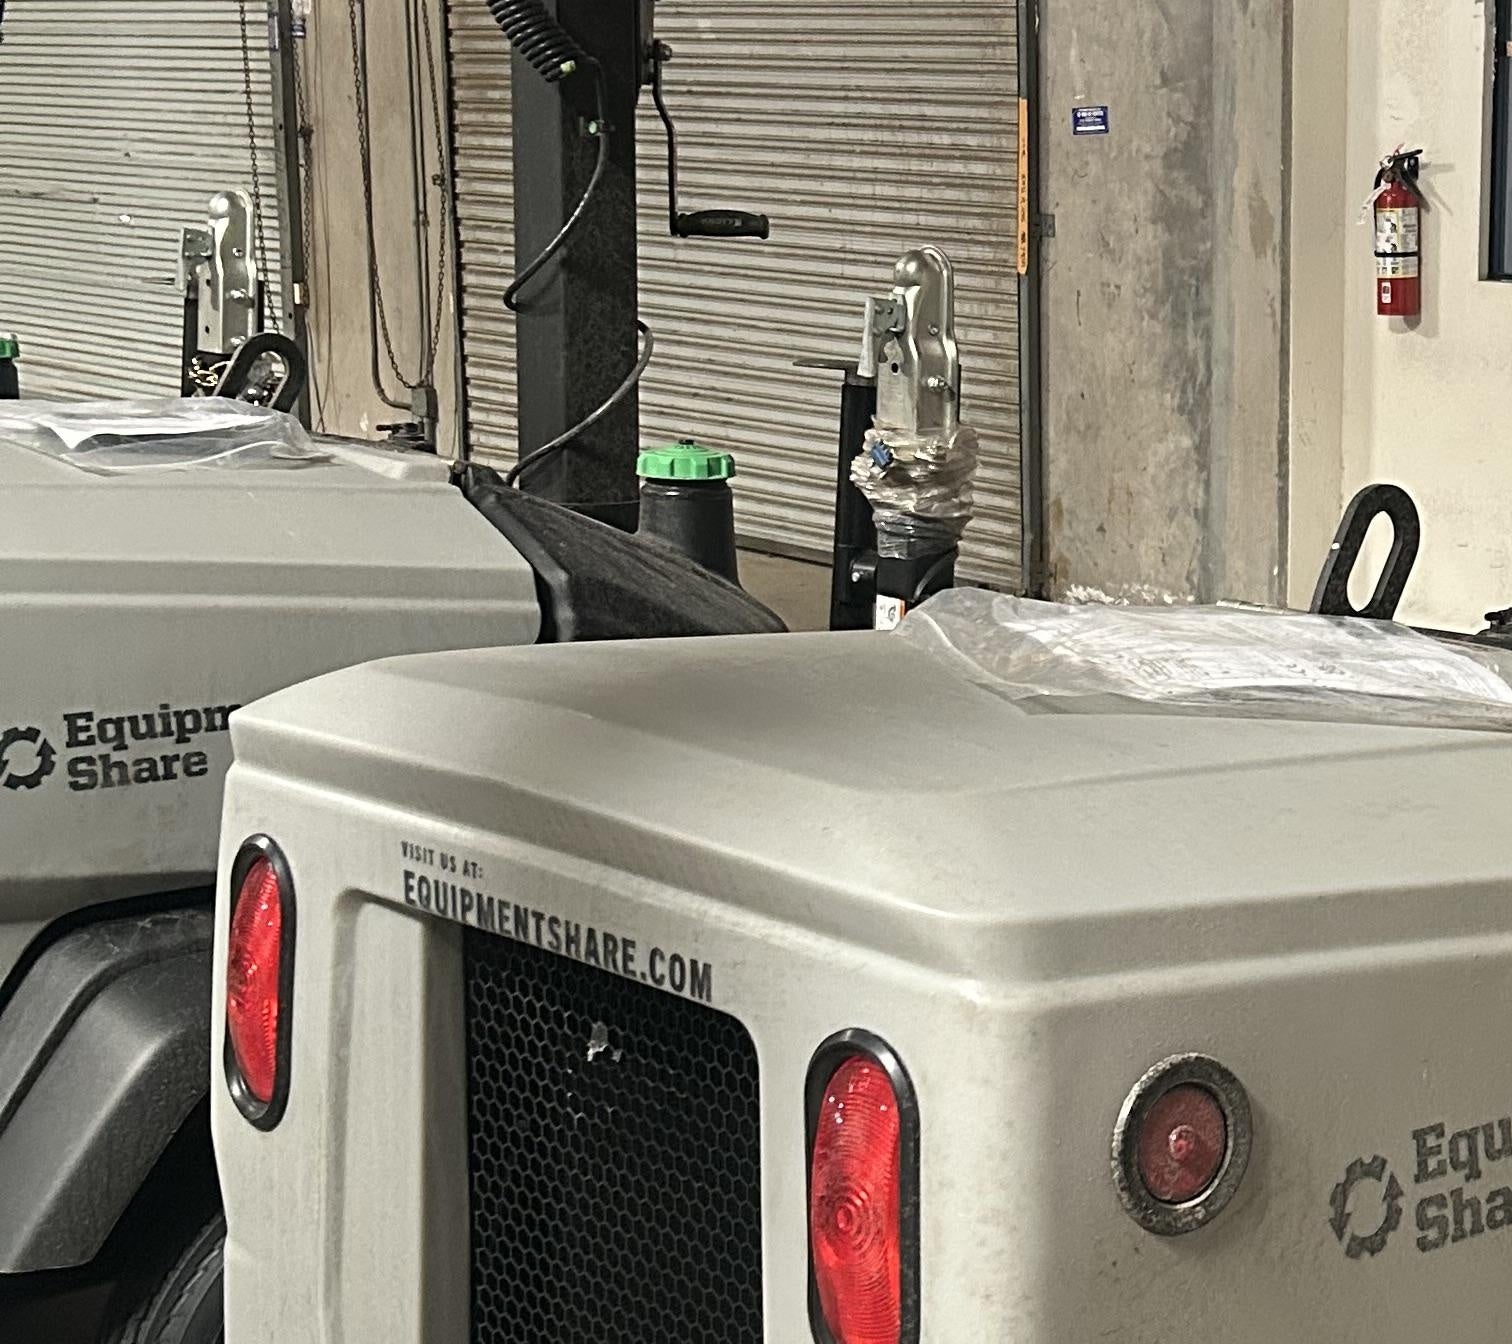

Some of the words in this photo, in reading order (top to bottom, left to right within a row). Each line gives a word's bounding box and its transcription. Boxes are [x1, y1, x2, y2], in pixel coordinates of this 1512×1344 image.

[67, 750, 208, 791] Share
[401, 841, 434, 866] VISIT
[440, 853, 457, 873] US
[462, 861, 484, 879] AT:
[403, 869, 713, 1003] EQUIPMENTSHARE.COM
